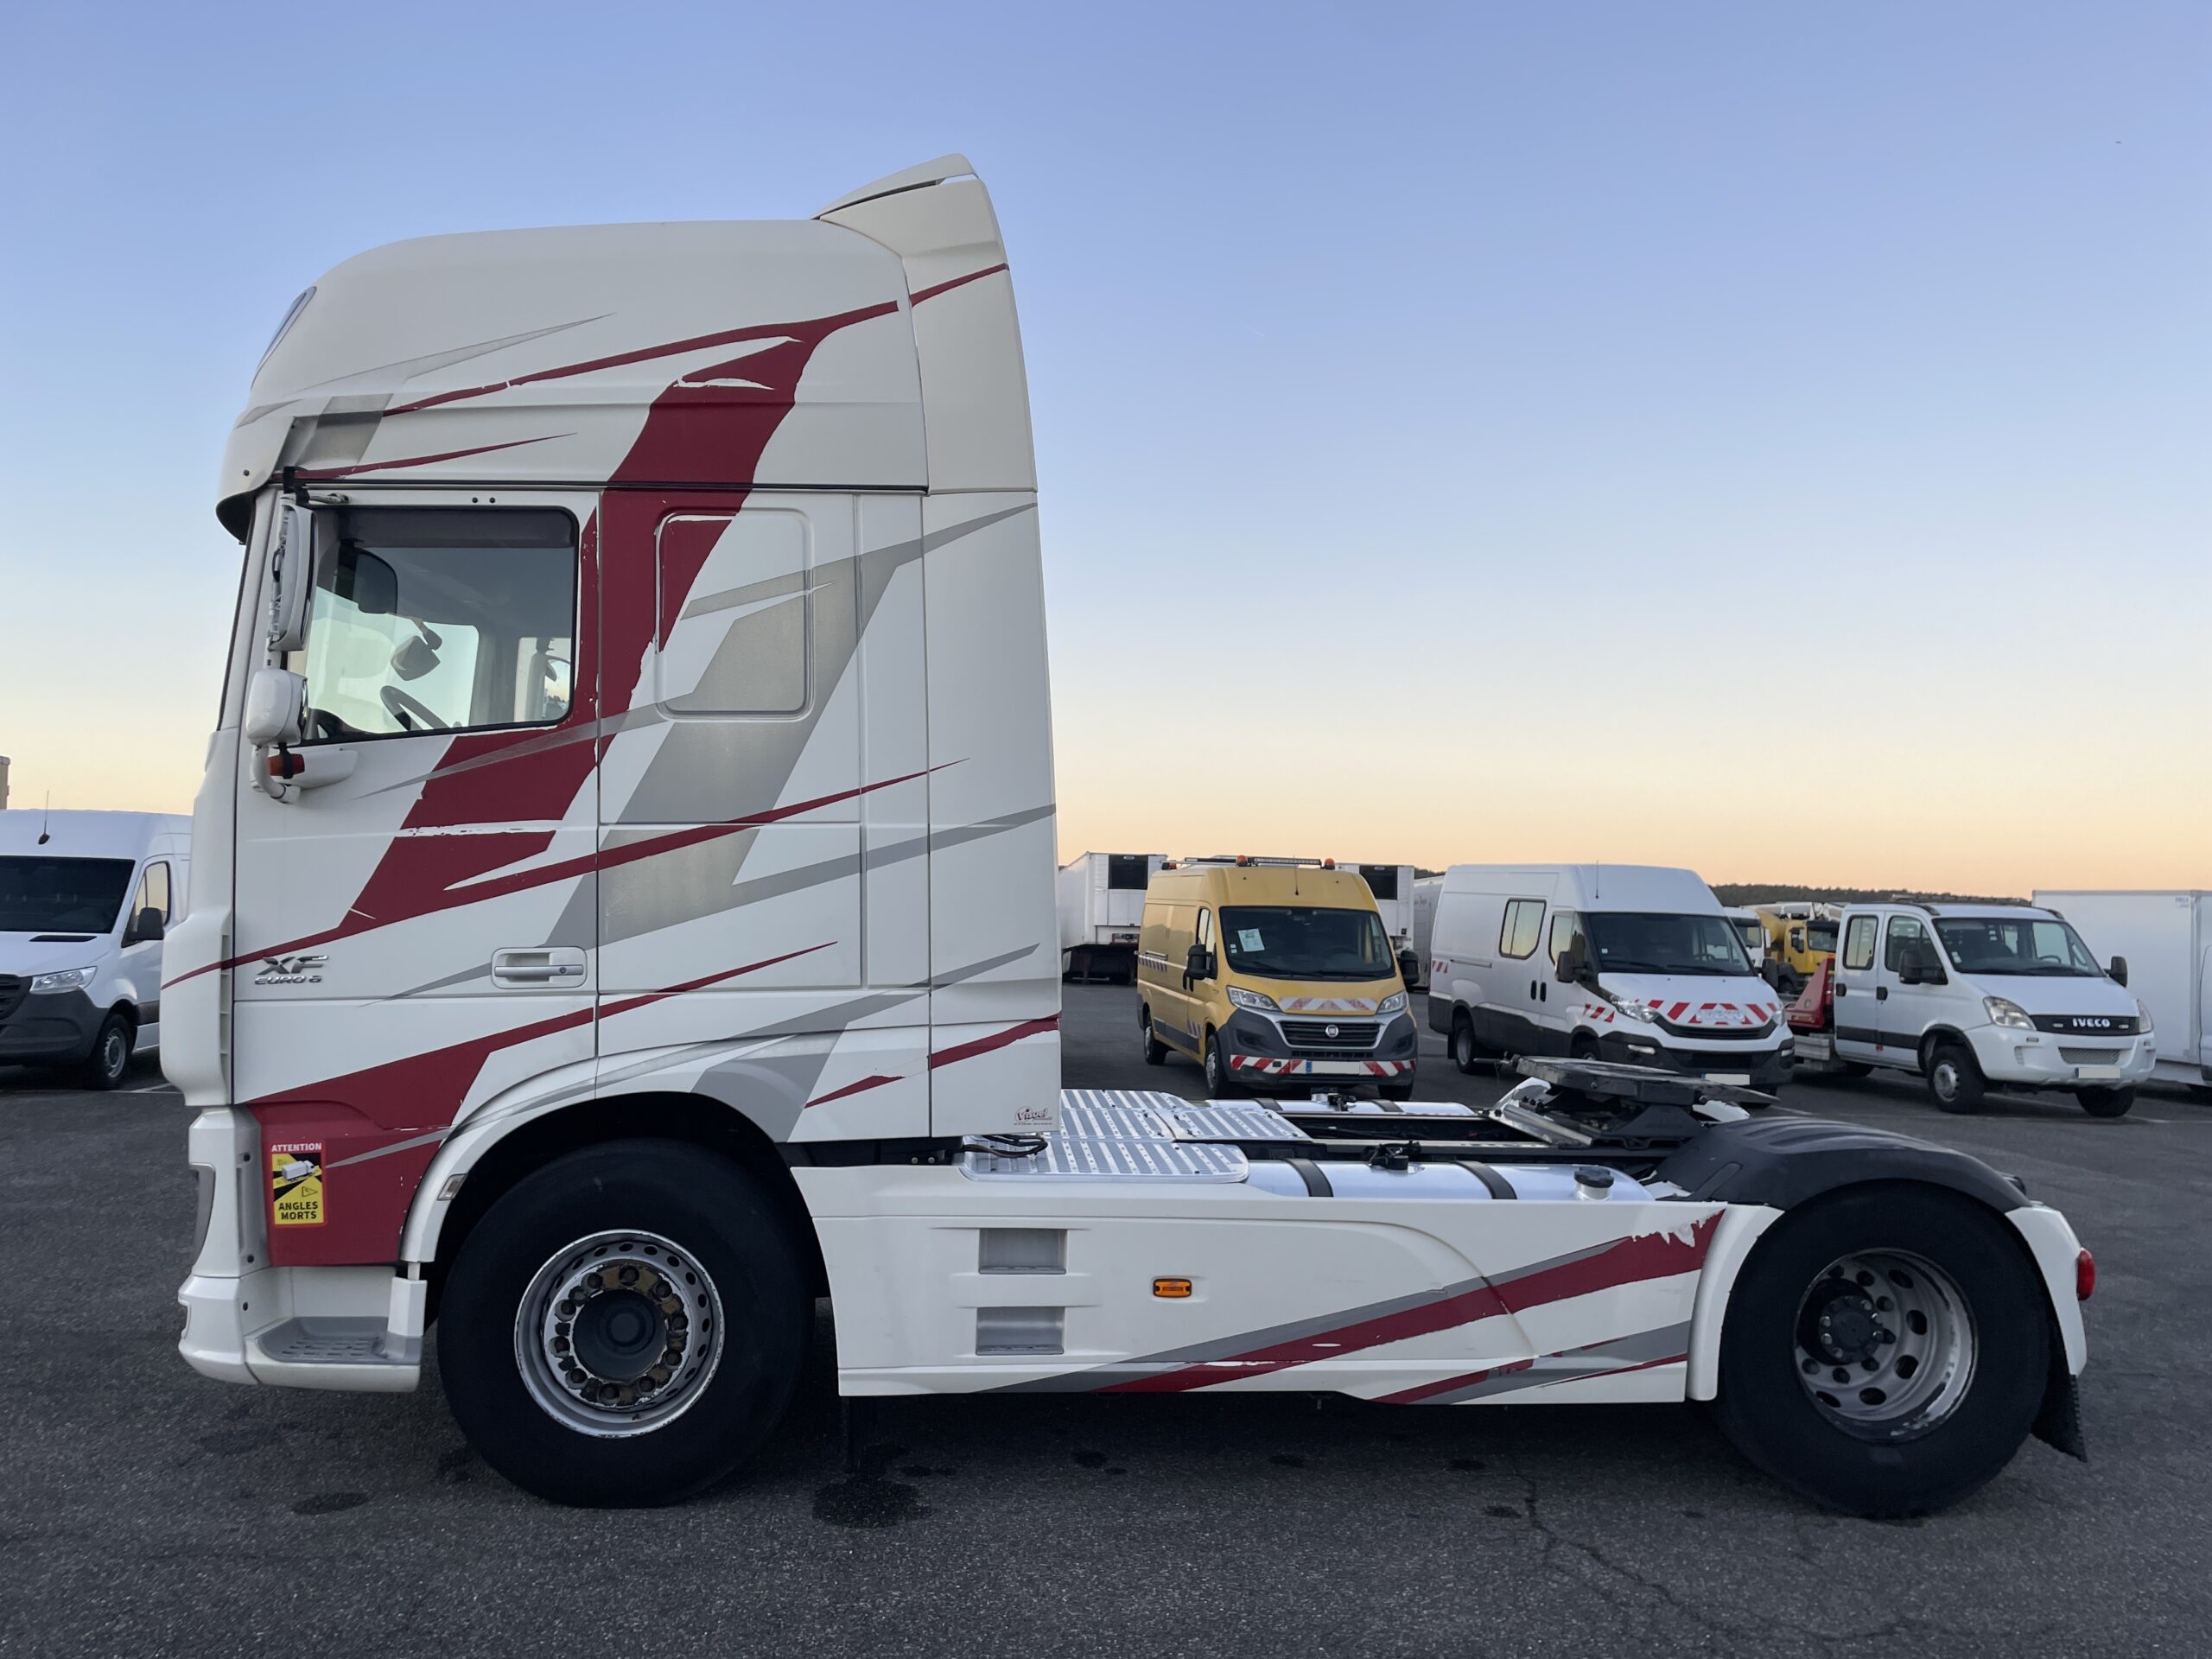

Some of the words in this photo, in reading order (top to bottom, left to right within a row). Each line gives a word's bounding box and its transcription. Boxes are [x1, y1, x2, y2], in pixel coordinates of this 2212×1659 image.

[257, 956, 328, 976] XF
[254, 976, 306, 985] EURO
[308, 975, 322, 983] 6
[2072, 1018, 2110, 1027] IVECO
[271, 1142, 321, 1153] ATTENTION
[278, 1201, 319, 1211] ANGLES
[281, 1211, 317, 1220] MORTS
